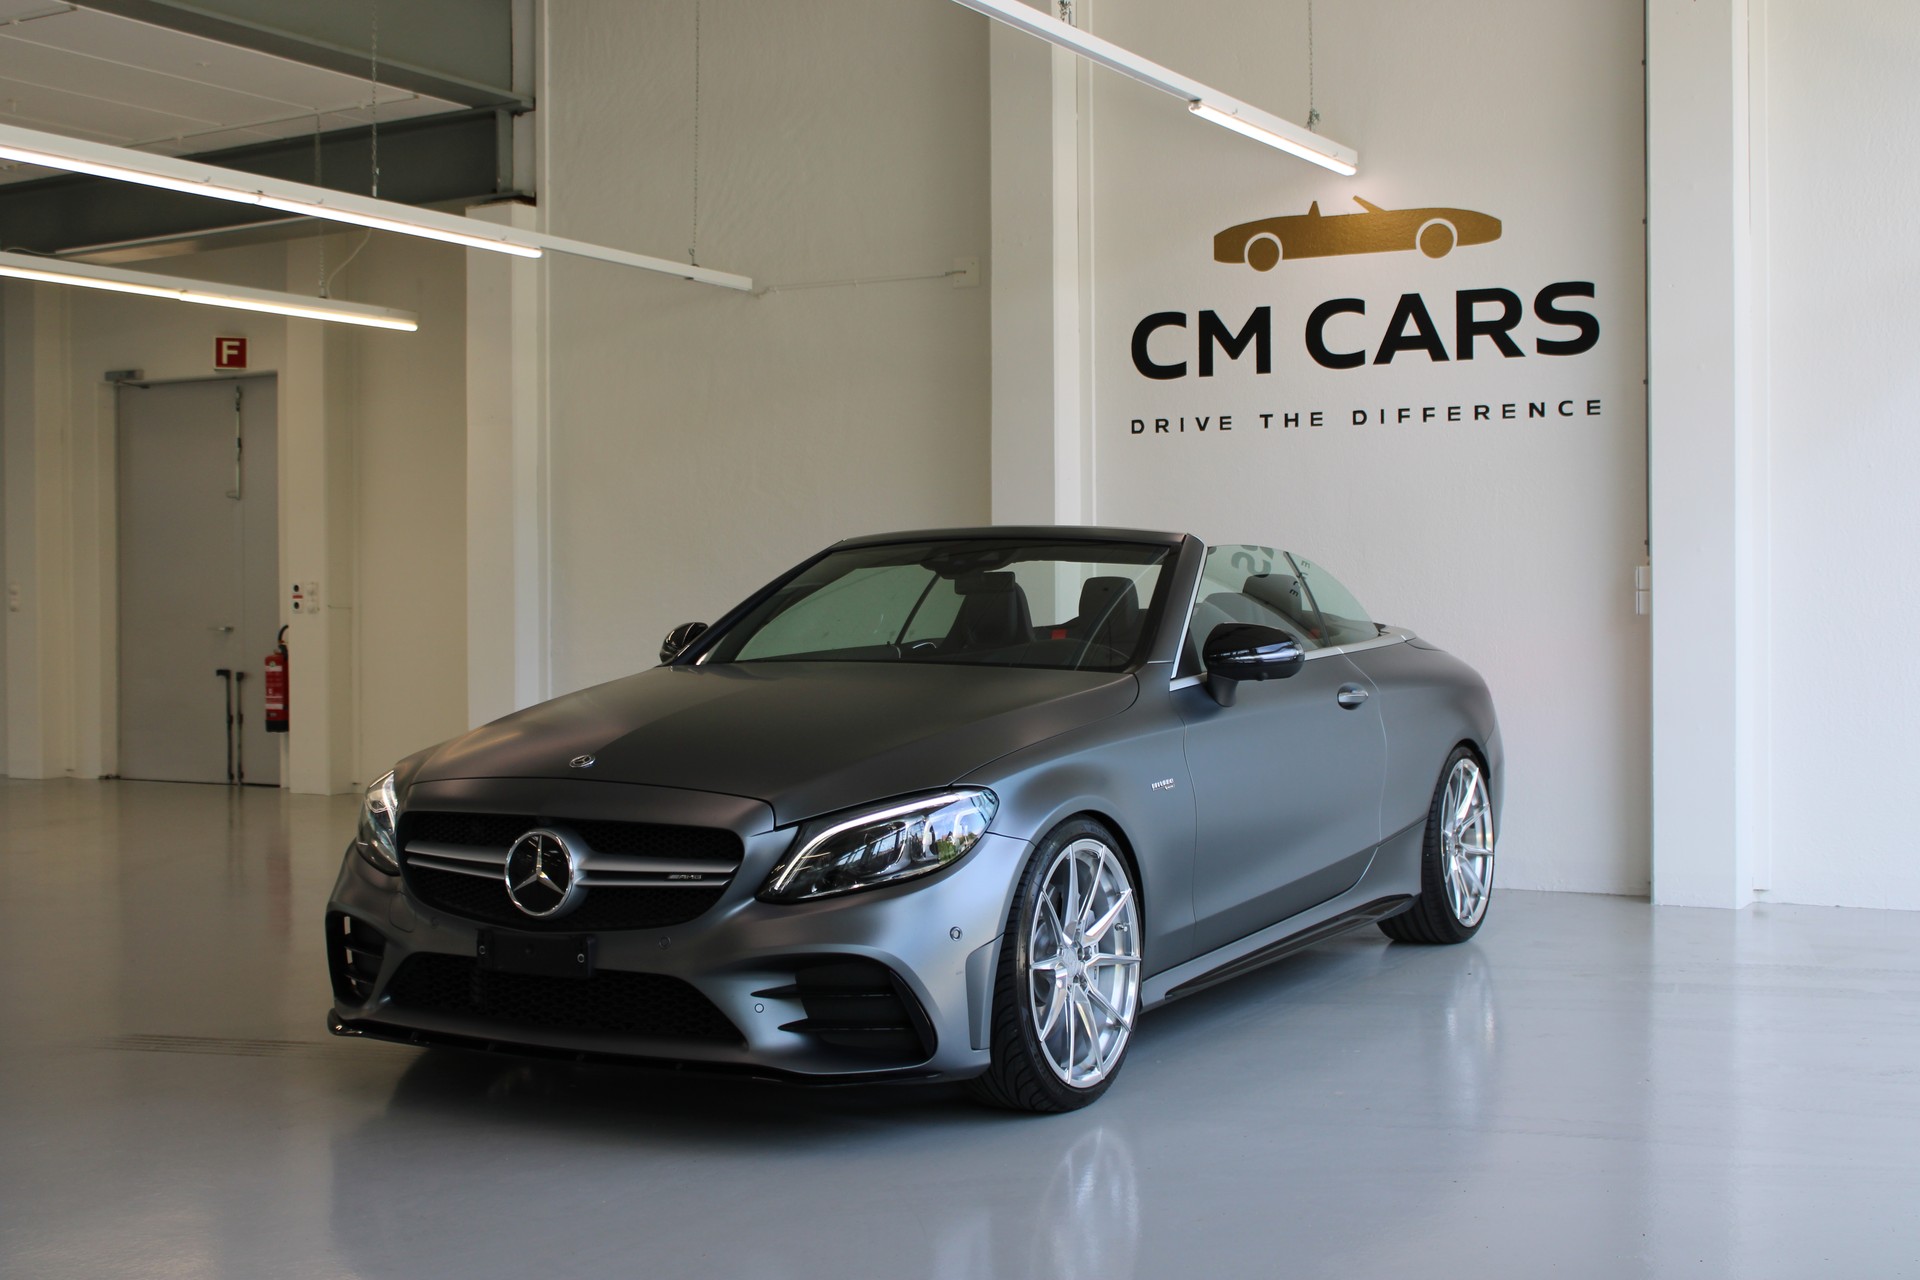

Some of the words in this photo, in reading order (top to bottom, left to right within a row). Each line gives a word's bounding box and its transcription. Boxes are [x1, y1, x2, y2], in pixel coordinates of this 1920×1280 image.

[1130, 305, 1272, 381] CM
[1304, 280, 1601, 370] CARS
[222, 341, 240, 364] F
[1130, 412, 1233, 435] DRIVE
[1259, 411, 1324, 429] THE
[1352, 399, 1602, 426] DIFFERENCE
